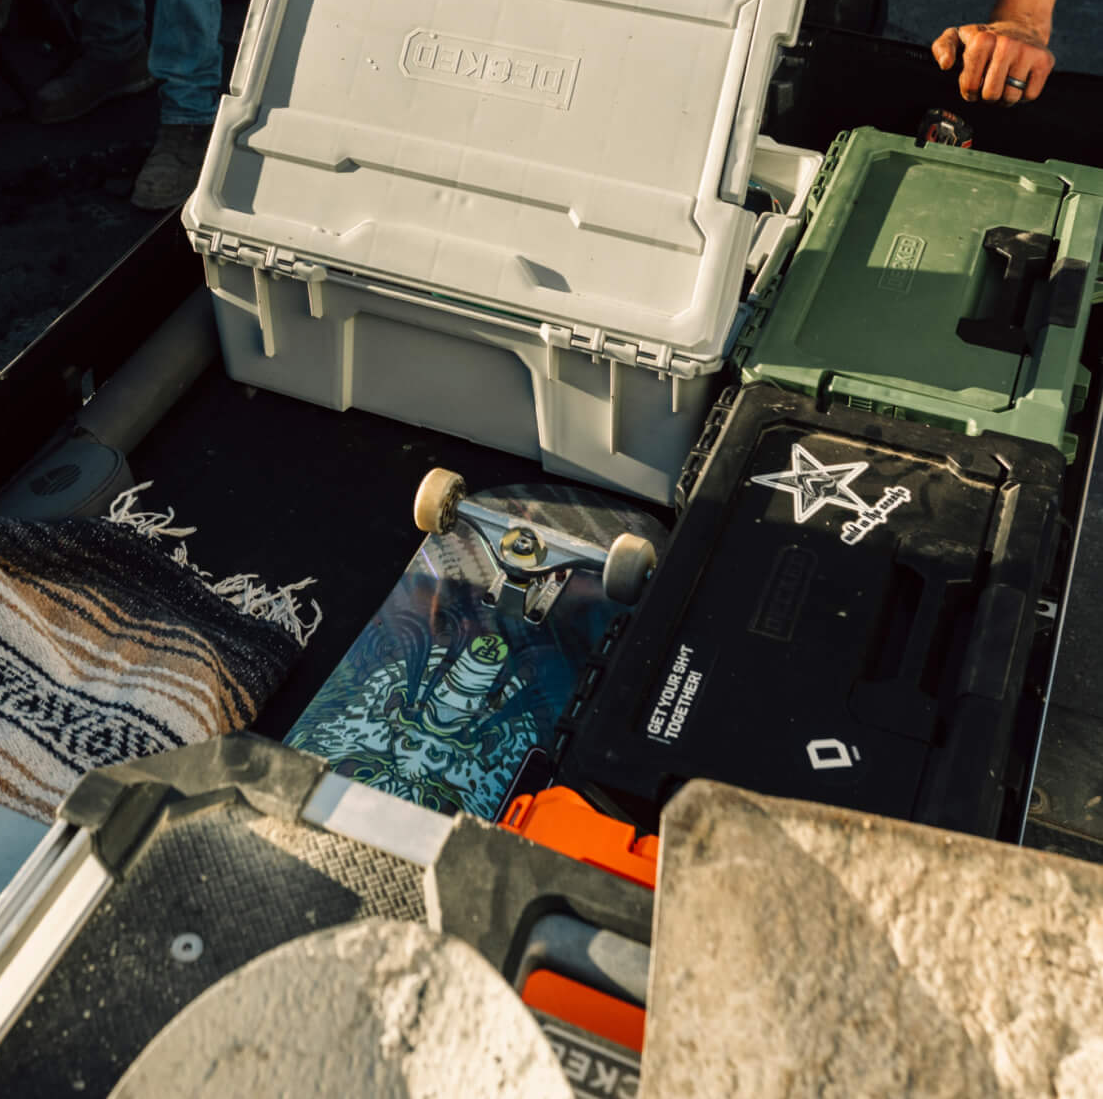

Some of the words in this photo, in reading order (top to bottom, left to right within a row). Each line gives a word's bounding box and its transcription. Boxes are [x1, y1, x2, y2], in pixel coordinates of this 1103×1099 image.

[412, 43, 569, 95] DECKED
[647, 706, 668, 736] GET
[658, 672, 683, 714] YOUR
[664, 669, 703, 740] TOGETHER!
